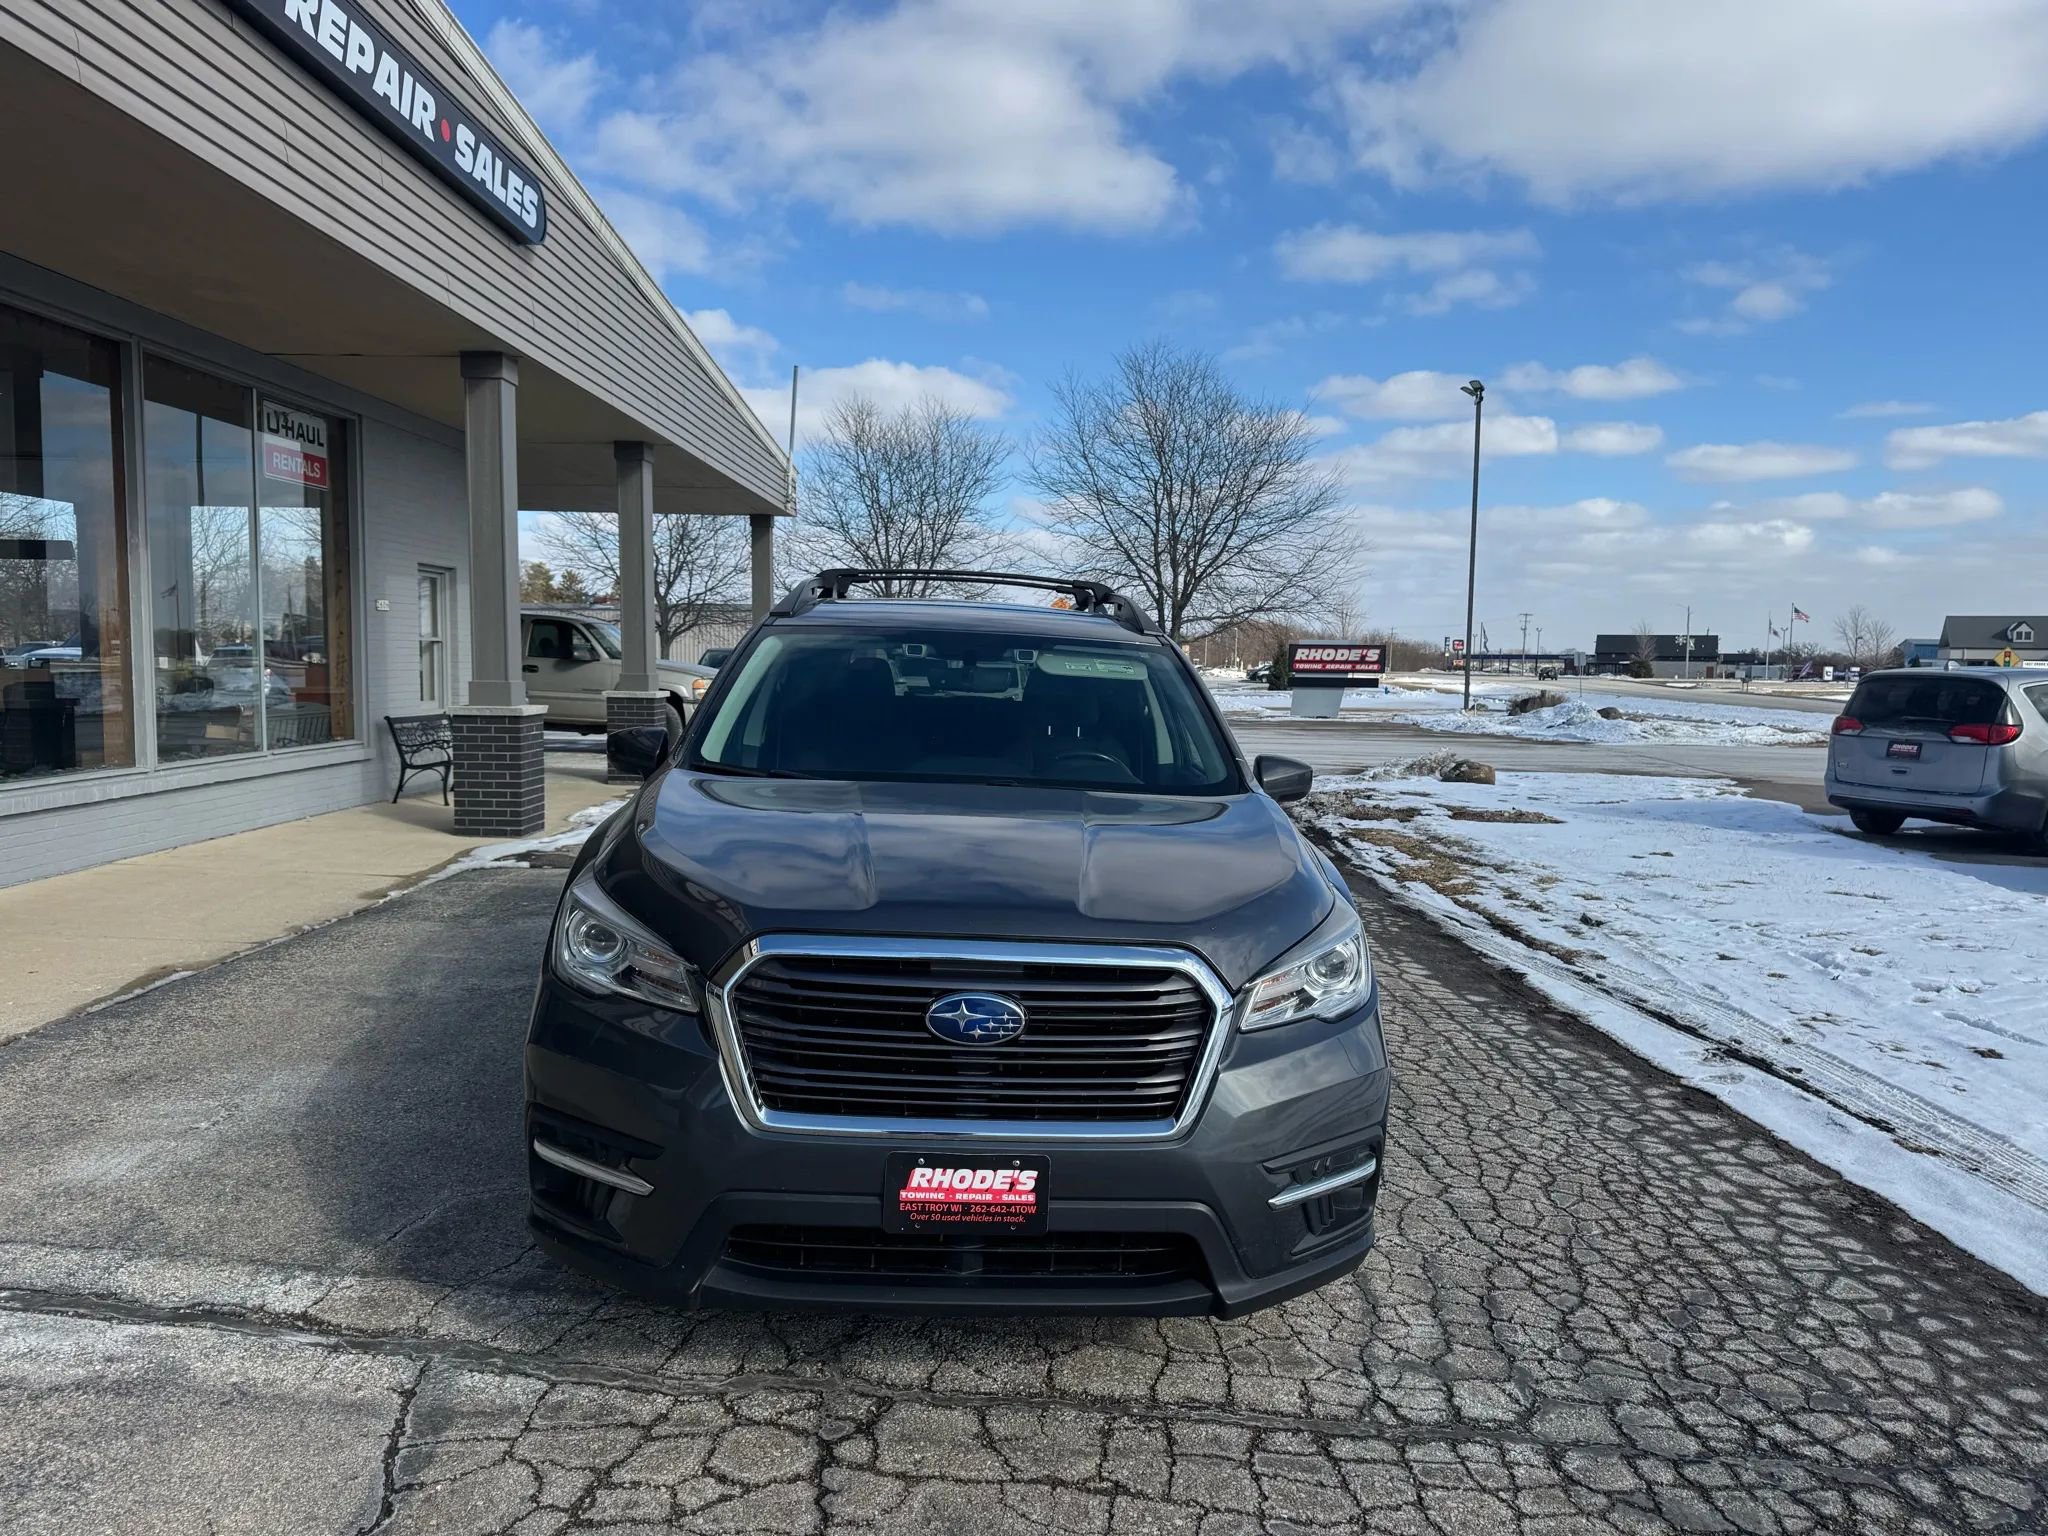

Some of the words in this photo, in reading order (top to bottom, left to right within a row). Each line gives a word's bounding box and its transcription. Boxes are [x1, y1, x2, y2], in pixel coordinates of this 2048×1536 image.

[285, 0, 437, 142] REPAIR
[454, 123, 539, 229] SALES
[272, 451, 321, 478] RENTALS
[1294, 648, 1380, 661] RHODE'S
[910, 1168, 1038, 1190] RHODE'S
[901, 1191, 945, 1199] TOWING
[955, 1193, 993, 1201] REPAIR
[900, 1202, 923, 1211] EAST
[924, 1203, 949, 1212] TROY
[950, 1204, 962, 1212] WI
[970, 1204, 1037, 1214] 262-642-4TOW
[910, 1212, 929, 1220] Over
[941, 1213, 961, 1221] used
[962, 1214, 993, 1222] vehicles
[993, 1214, 1002, 1222] in
[1003, 1215, 1026, 1223] stock.
